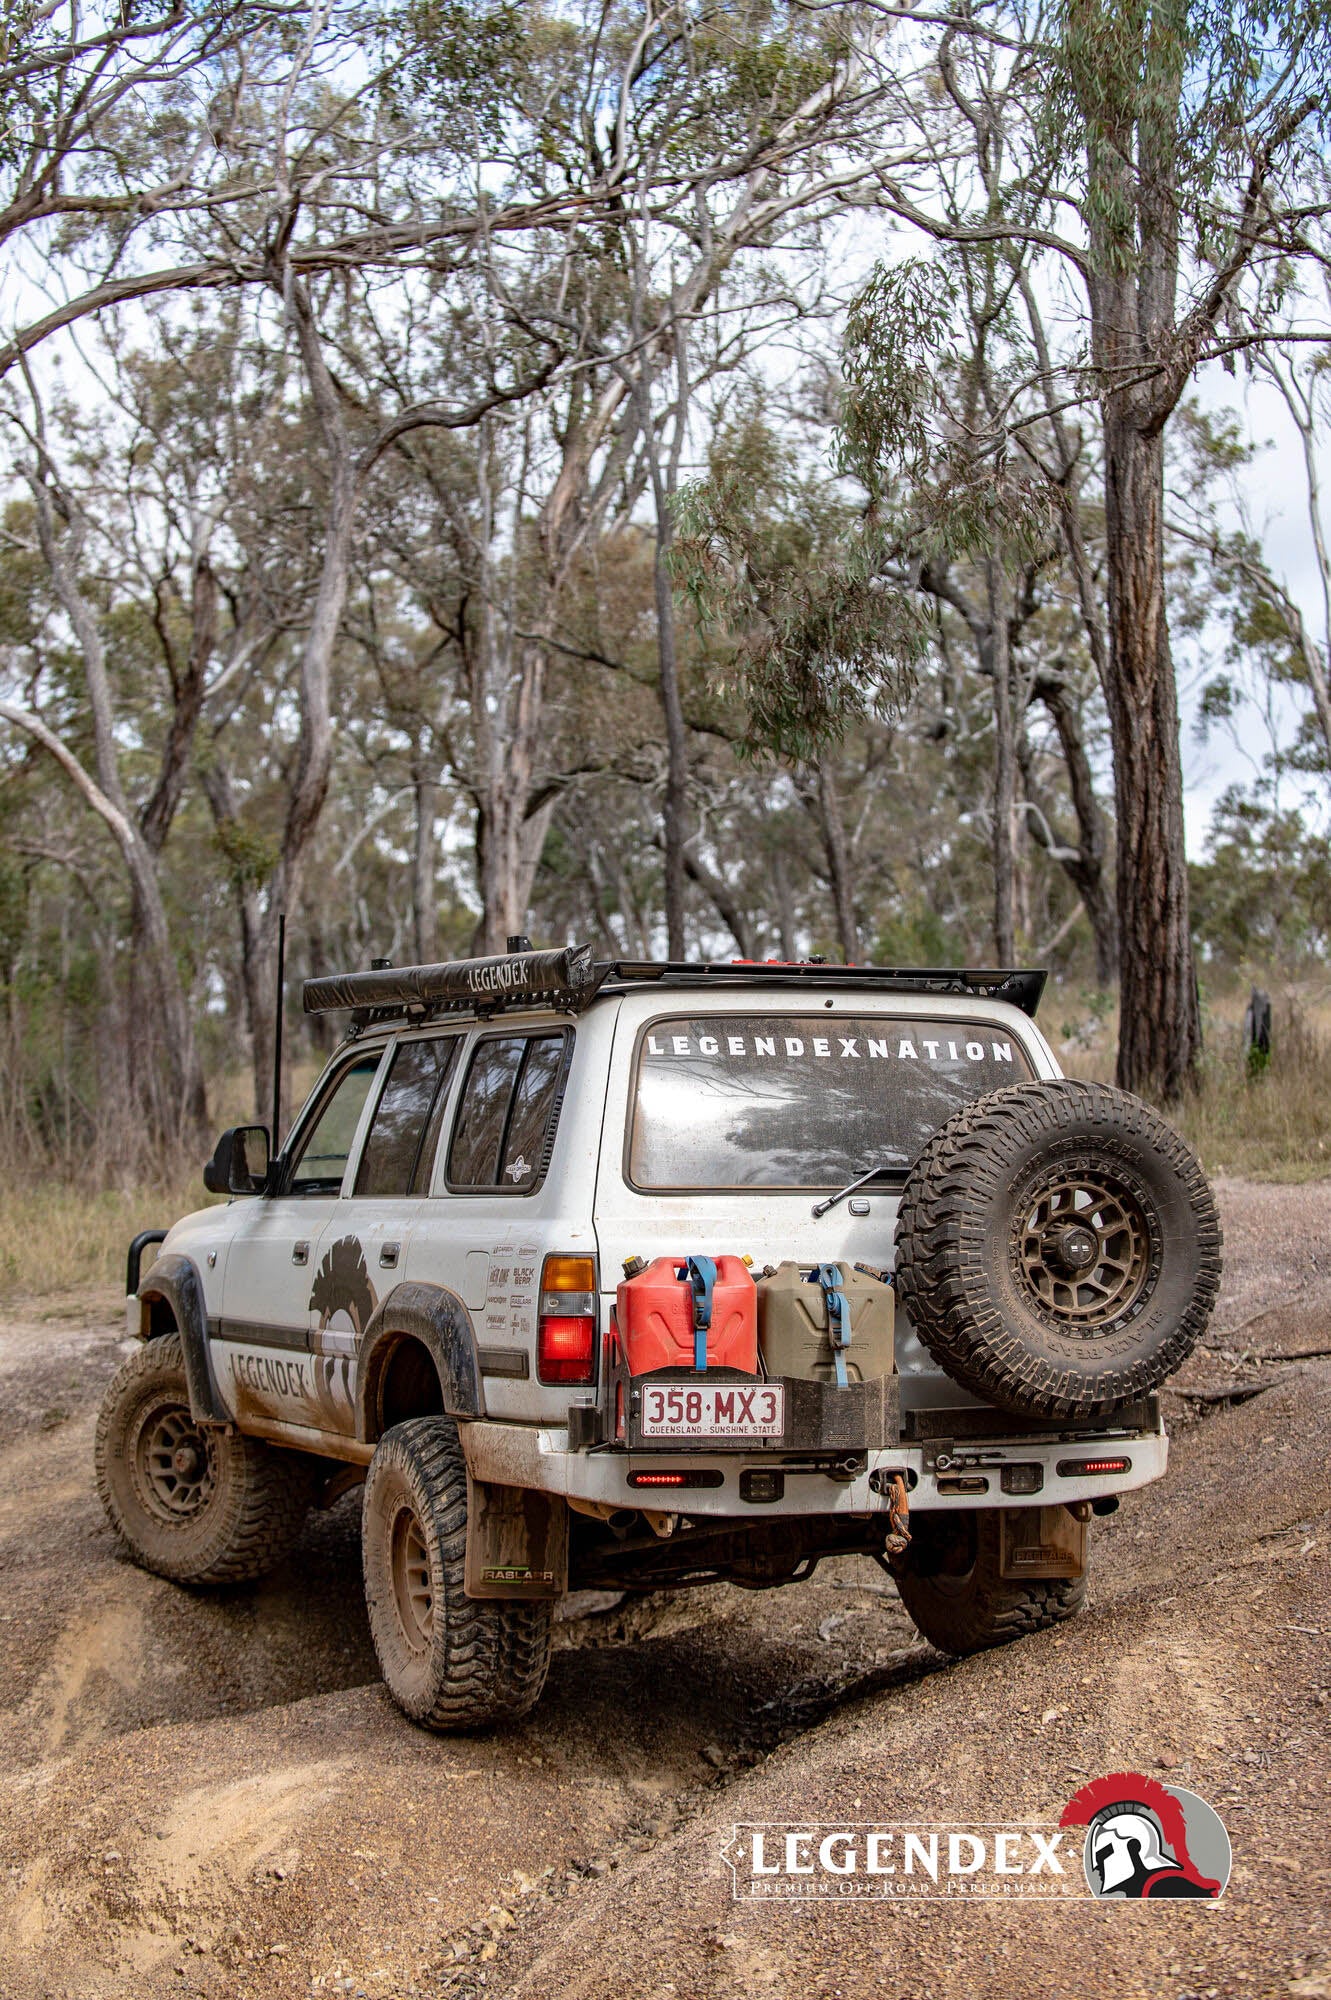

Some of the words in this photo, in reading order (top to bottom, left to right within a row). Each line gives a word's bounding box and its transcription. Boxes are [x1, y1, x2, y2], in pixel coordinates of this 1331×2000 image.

[468, 960, 528, 993] LEGENDEX
[648, 1036, 1012, 1062] LEGENDEXNATION
[513, 1267, 535, 1277] BLACK
[230, 1353, 310, 1399] LEGENDEX
[650, 1425, 702, 1434] QUEENSLAND
[709, 1425, 749, 1434] SUNSHINE
[752, 1425, 776, 1434] STATE
